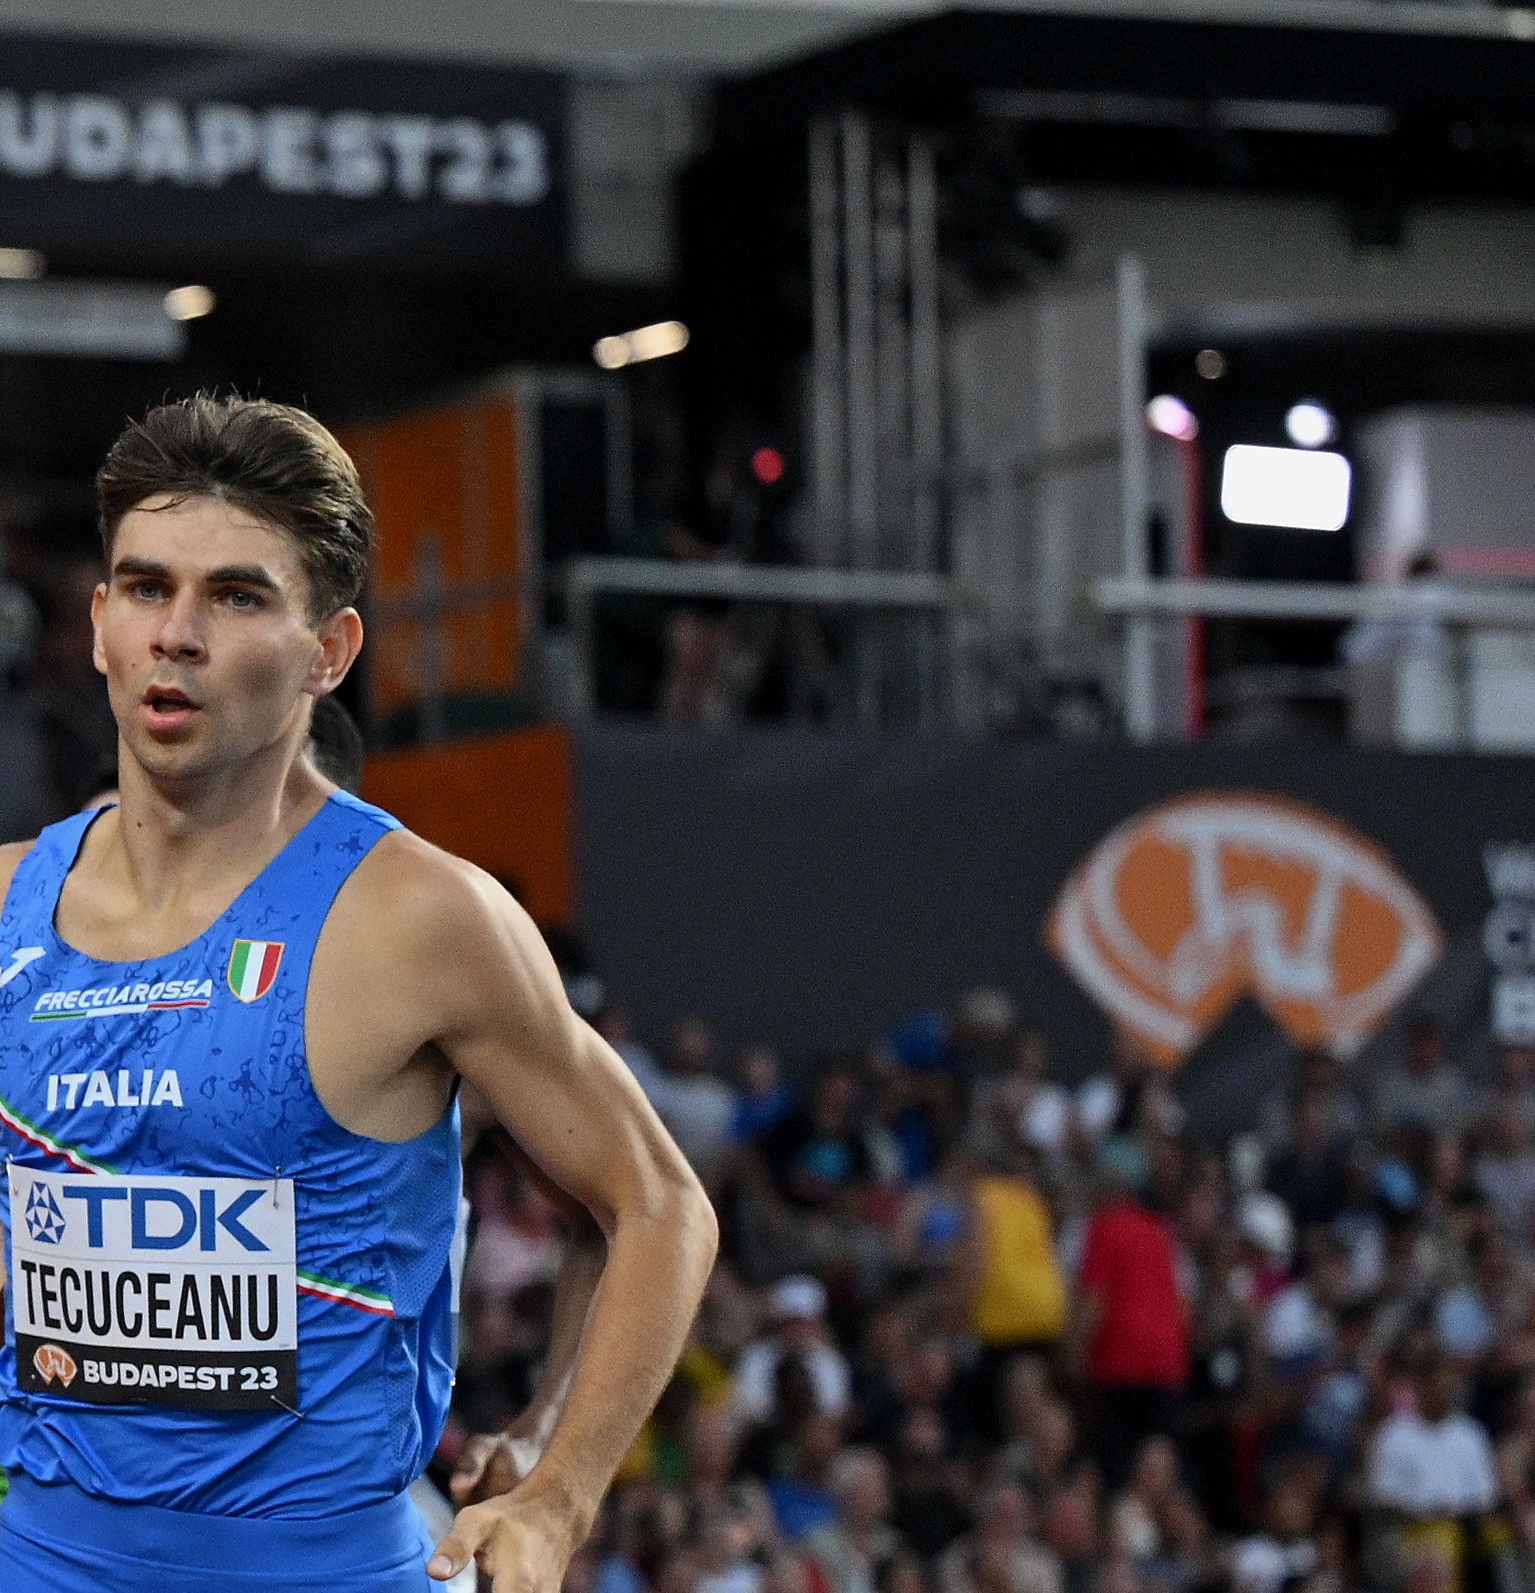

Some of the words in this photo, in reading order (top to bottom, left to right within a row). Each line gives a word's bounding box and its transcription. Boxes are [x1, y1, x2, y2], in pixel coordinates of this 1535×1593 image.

[35, 979, 212, 1010] FRECCIAROSSA
[47, 1069, 183, 1111] ITALIA
[63, 1186, 272, 1252] TDK
[21, 1259, 279, 1341] TECUCEANU
[83, 1361, 235, 1391] BUDAPEST
[241, 1366, 278, 1391] 23
